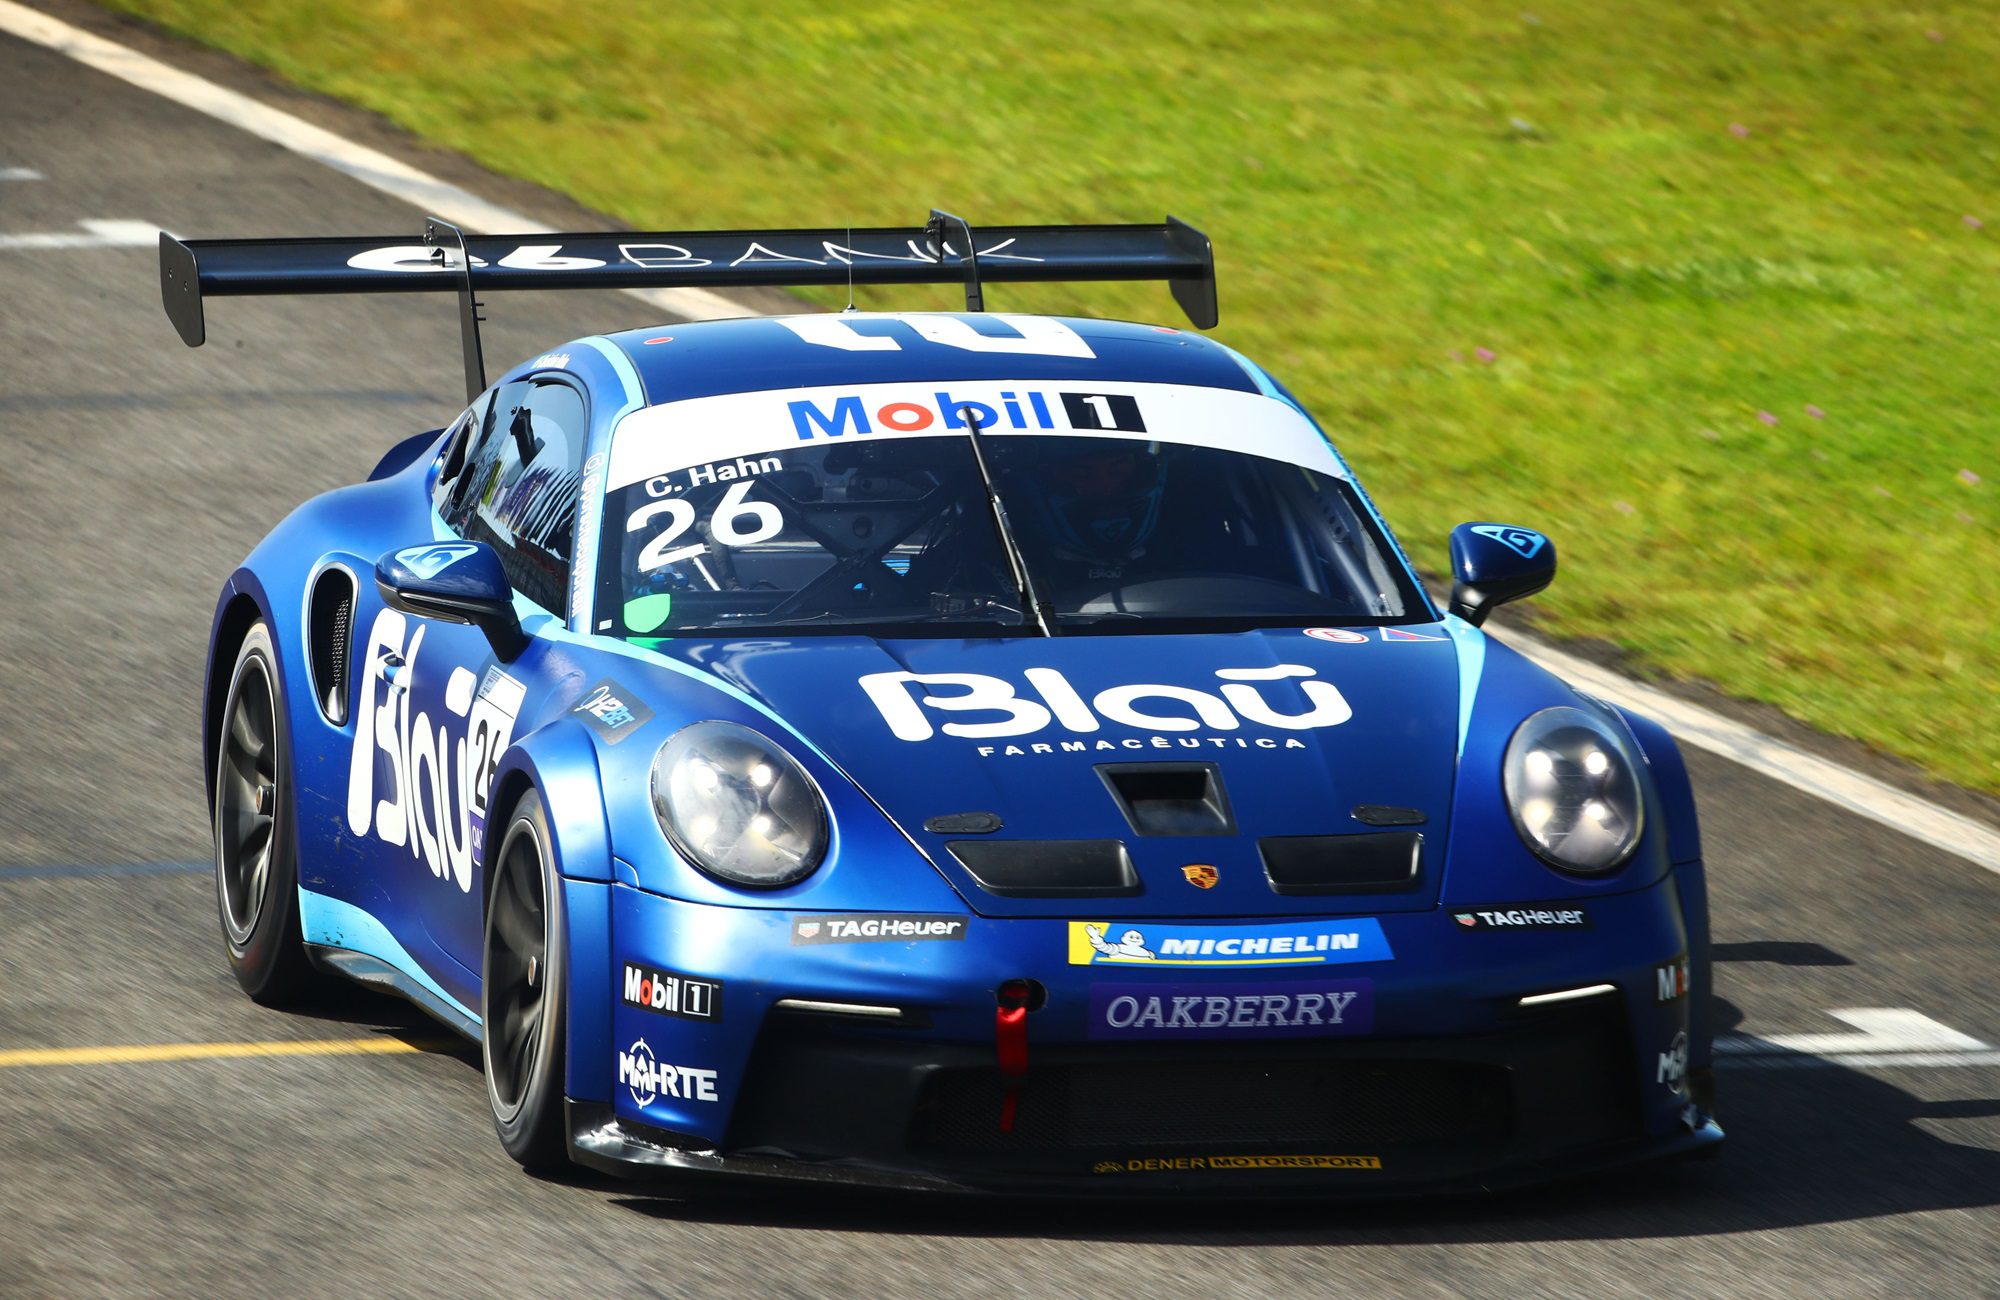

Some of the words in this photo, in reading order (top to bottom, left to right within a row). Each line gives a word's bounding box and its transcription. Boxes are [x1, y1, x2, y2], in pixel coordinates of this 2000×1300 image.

[787, 391, 1055, 441] Mobil
[645, 475, 683, 498] C.
[688, 457, 783, 487] Hahn
[626, 480, 784, 573] 26
[977, 736, 1306, 757] FARMACÊUTICA
[1160, 933, 1359, 955] MICHELIN
[625, 966, 679, 1012] Mobil
[1106, 992, 1357, 1028] OAKBERRY
[1128, 1158, 1205, 1171] DENER
[1214, 1156, 1377, 1169] MOTORSPORT
